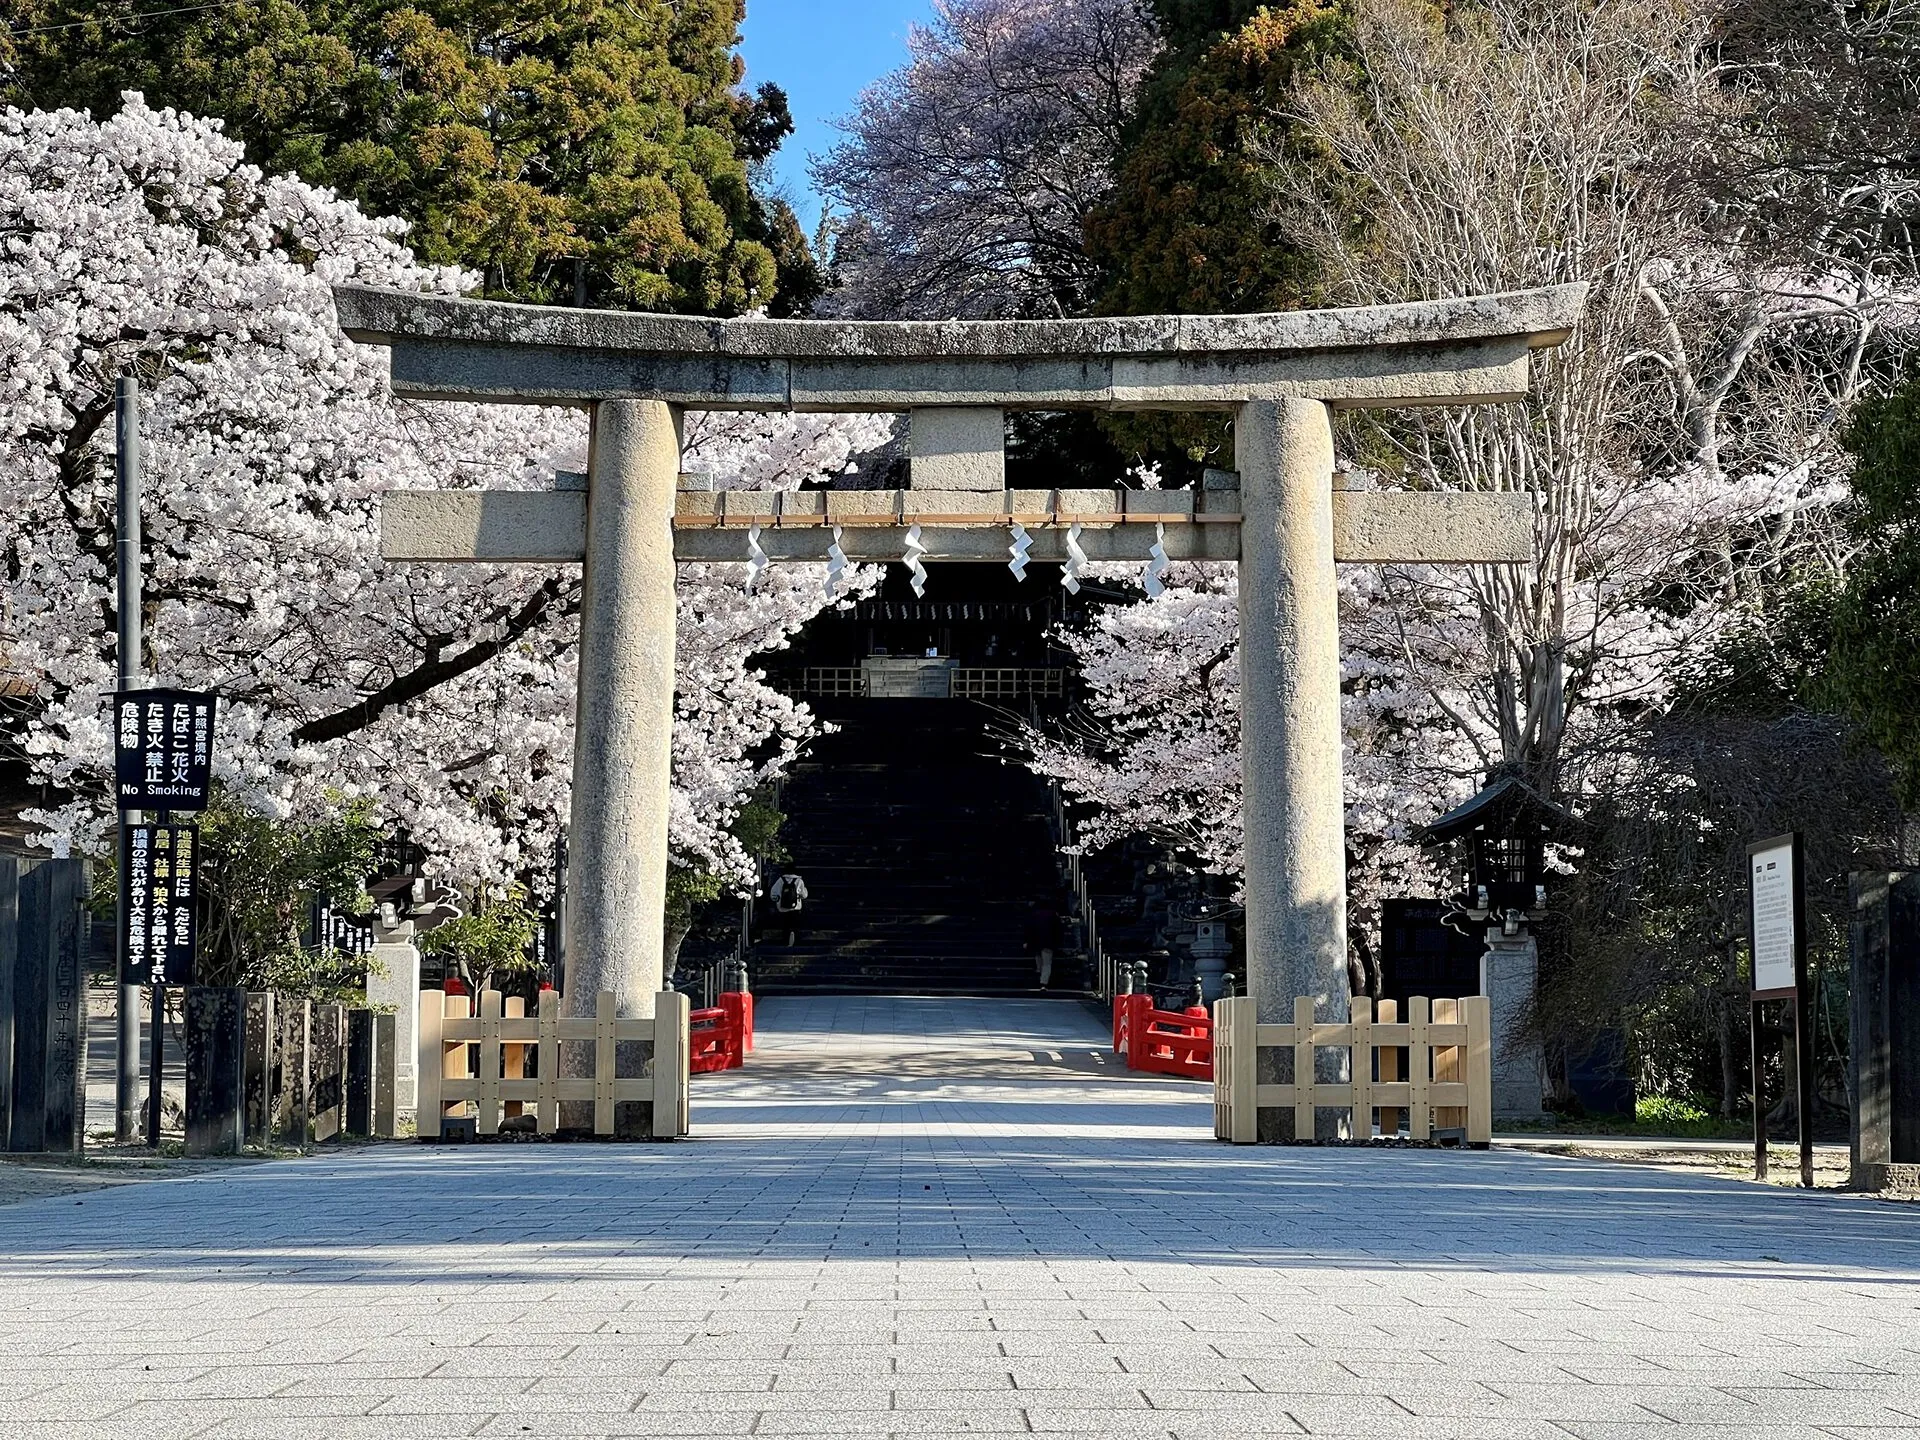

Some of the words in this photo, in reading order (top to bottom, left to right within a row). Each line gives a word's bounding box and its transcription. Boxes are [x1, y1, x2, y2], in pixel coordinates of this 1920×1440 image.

[120, 701, 140, 749] 危険物
[194, 705, 208, 766] 東照宮境内
[122, 784, 139, 795] No
[147, 784, 201, 797] Smoking
[128, 828, 148, 966] 損壊の恐れがあり大変危険です
